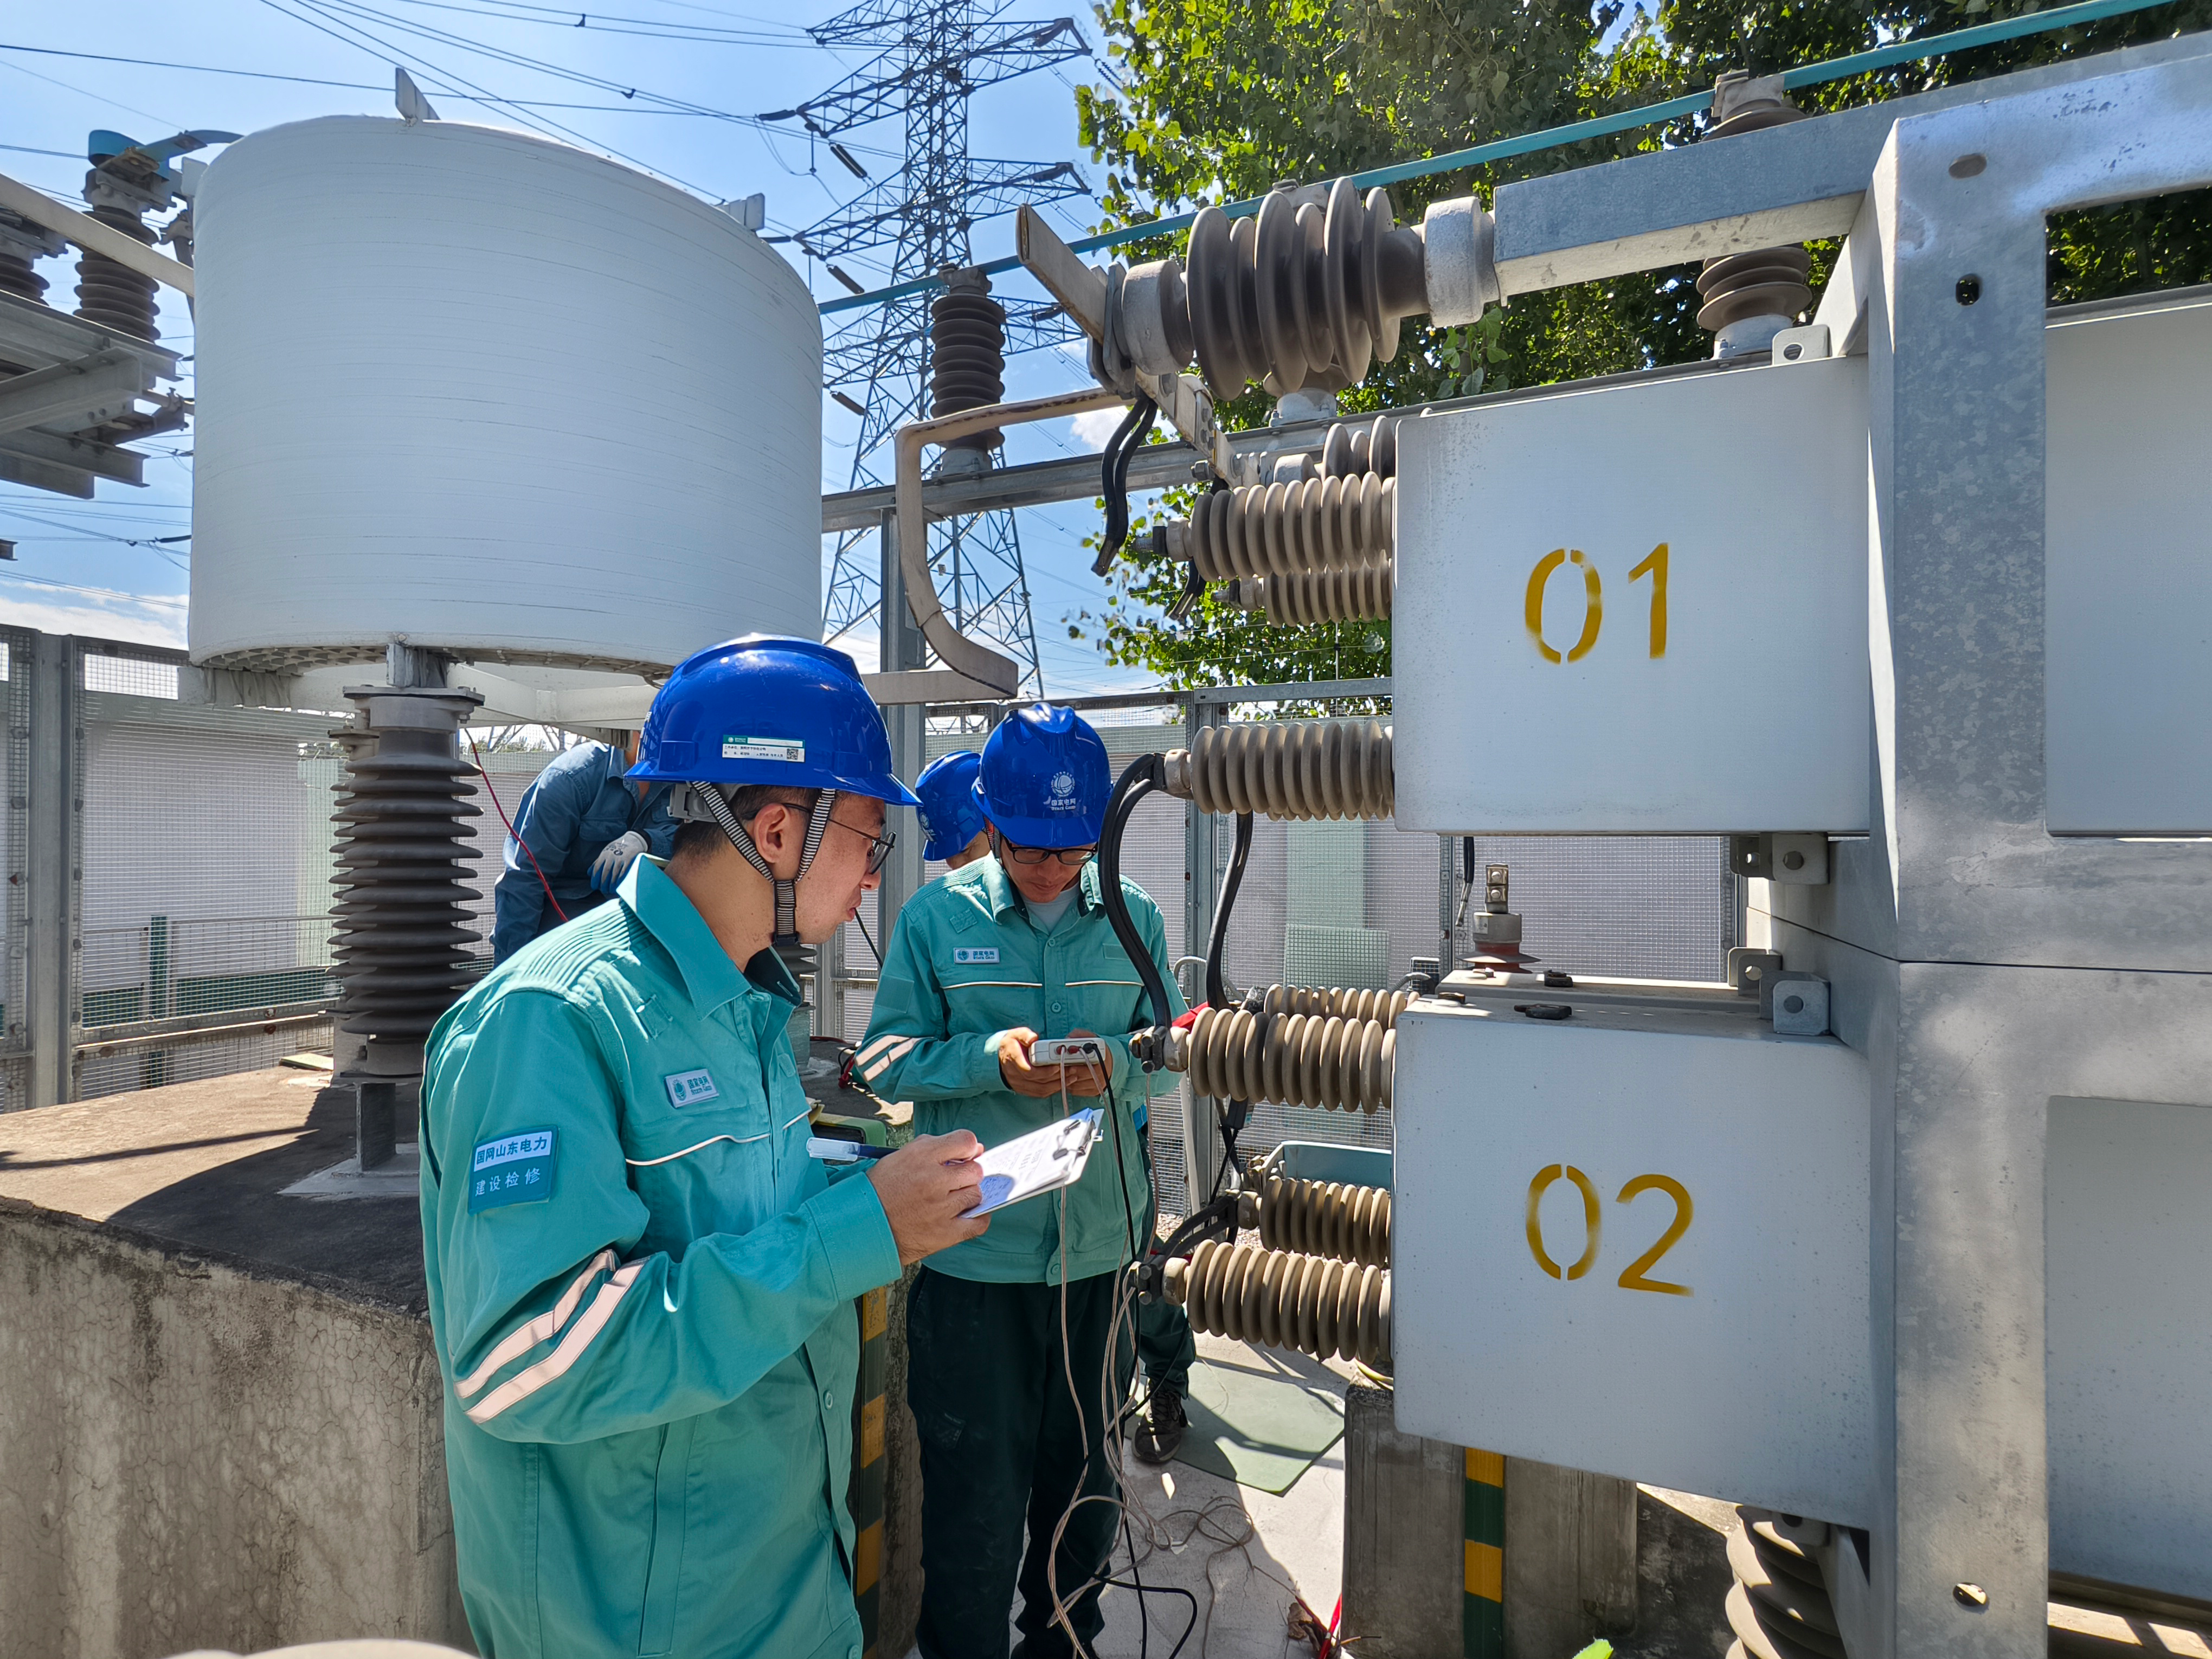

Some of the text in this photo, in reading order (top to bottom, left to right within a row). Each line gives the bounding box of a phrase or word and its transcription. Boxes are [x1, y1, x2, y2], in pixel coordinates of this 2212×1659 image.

[1525, 542, 1668, 665] 01
[475, 1167, 541, 1197] 建设检修
[477, 1136, 547, 1165] 国网山东电力
[1526, 1163, 1694, 1297] 02
